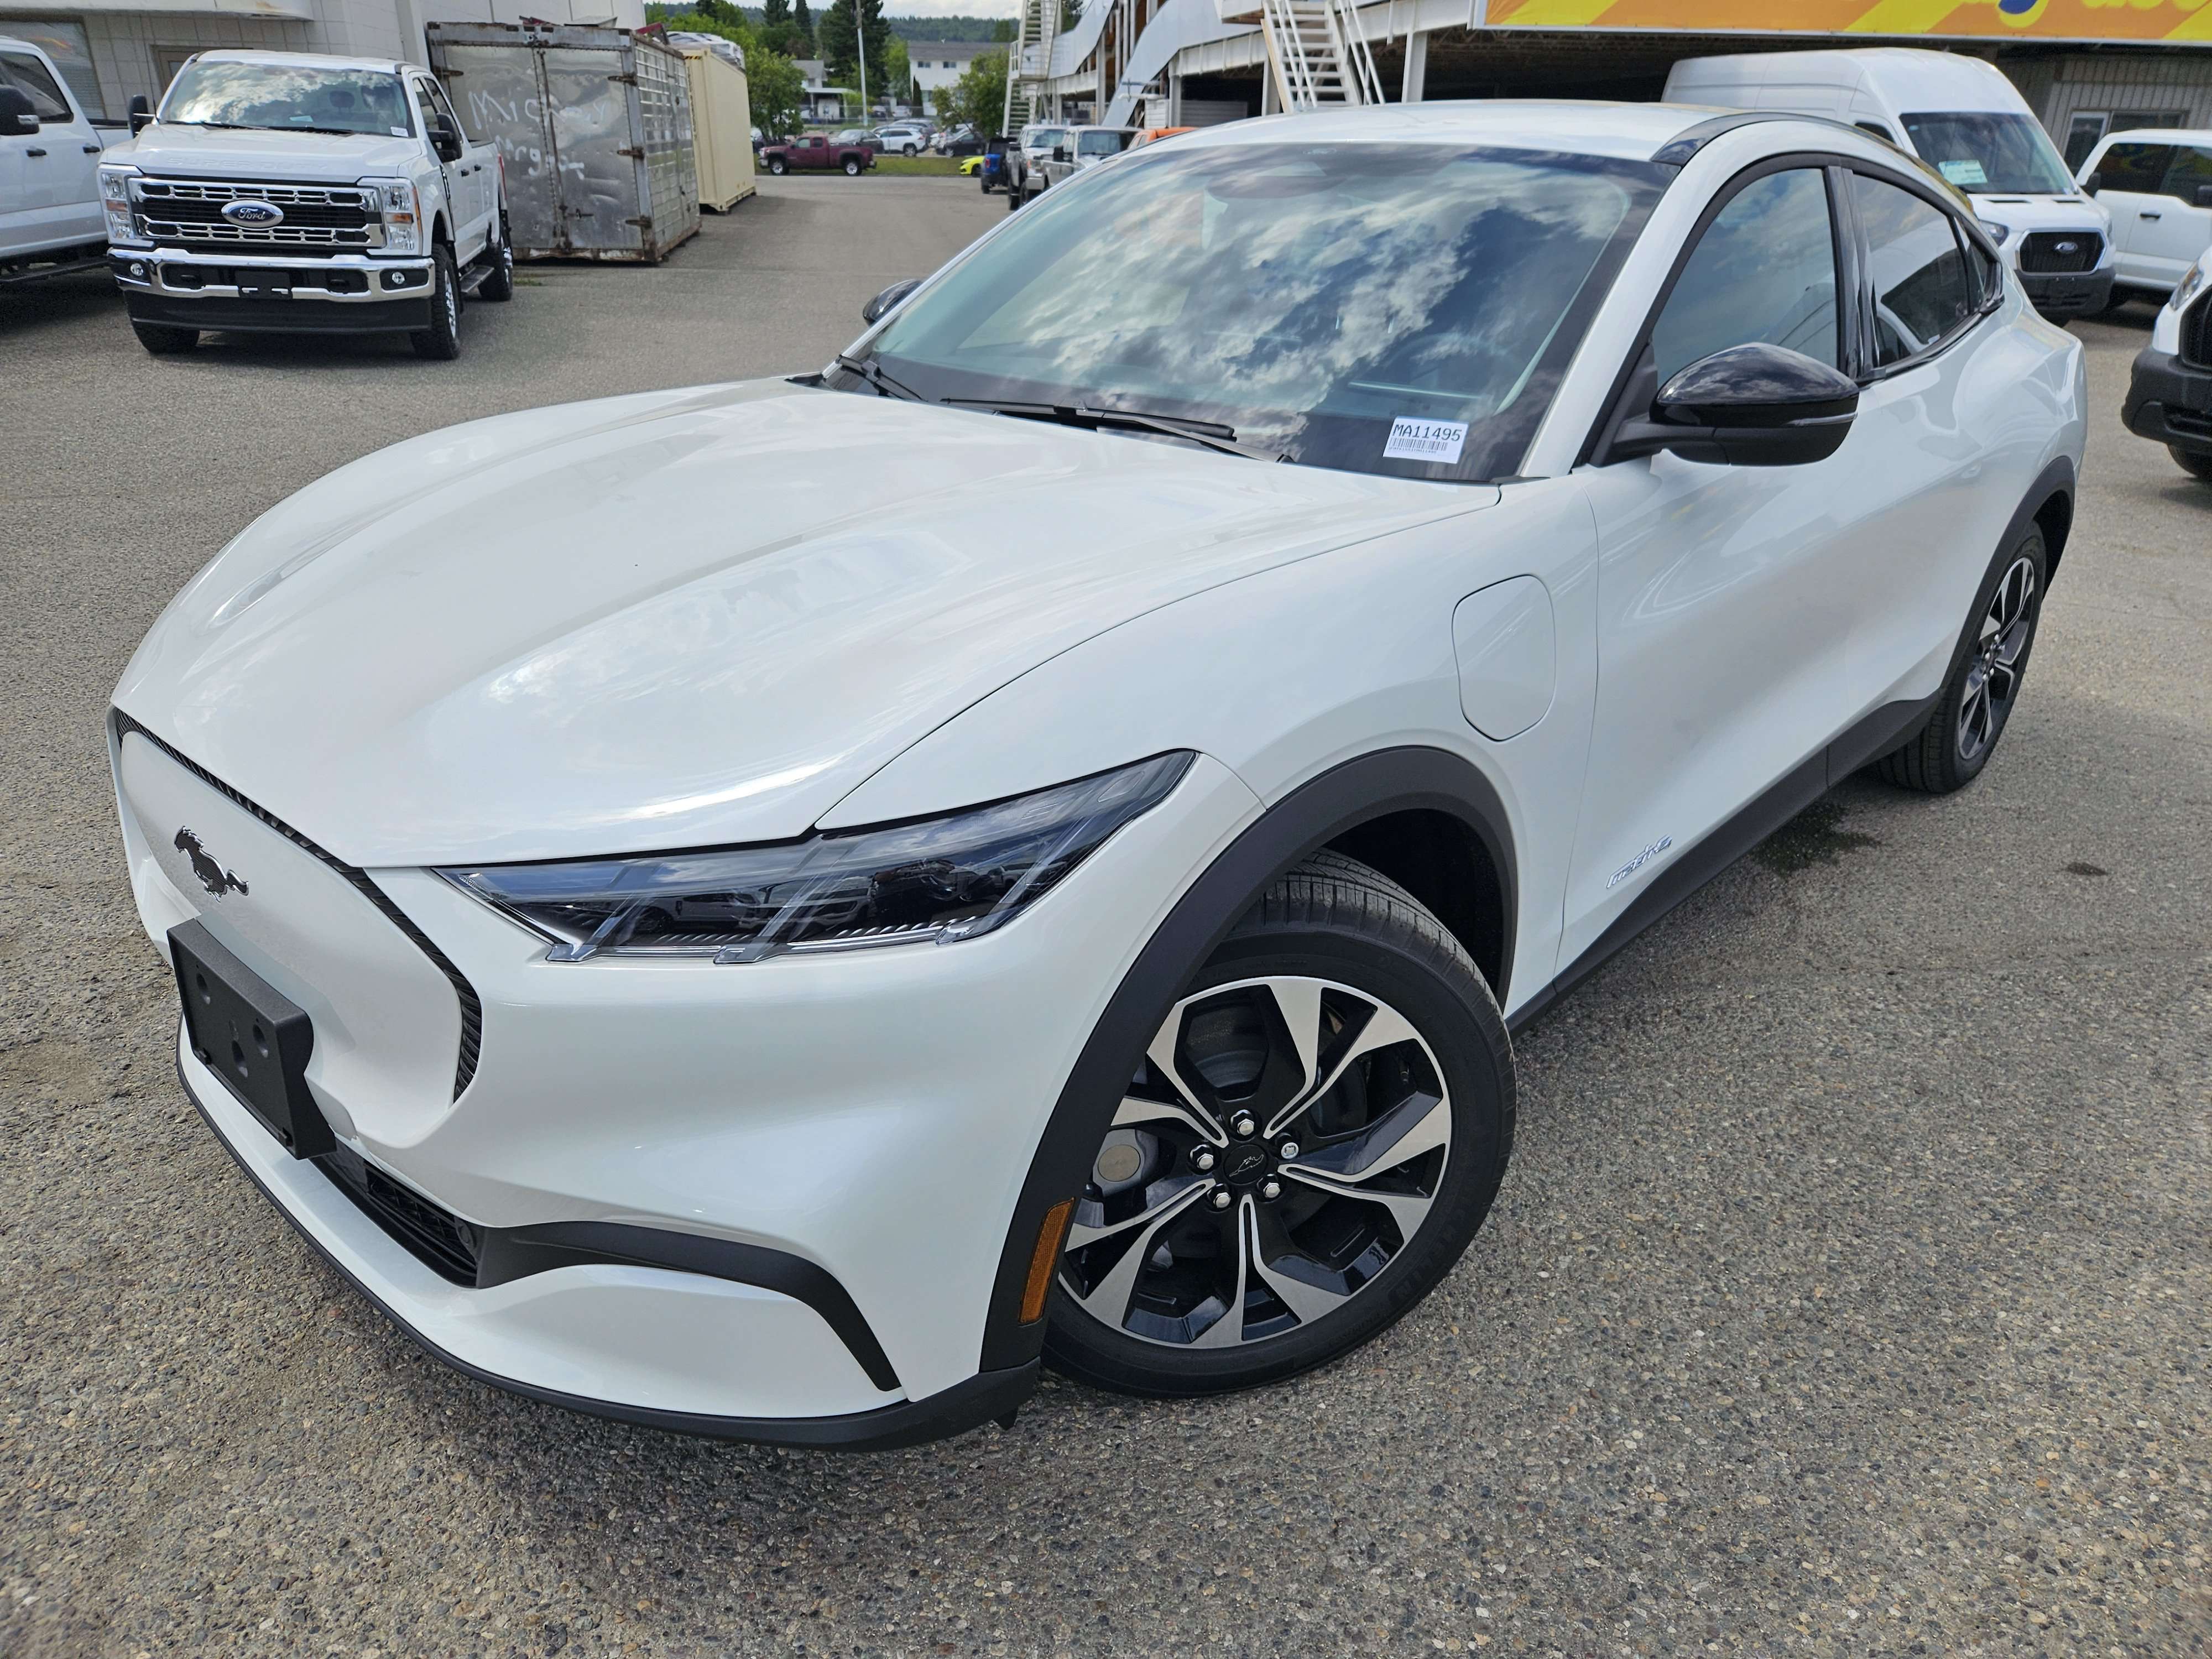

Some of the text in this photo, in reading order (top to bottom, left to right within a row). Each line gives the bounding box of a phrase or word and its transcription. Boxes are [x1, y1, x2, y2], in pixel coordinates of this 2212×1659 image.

[166, 156, 330, 172] SUPER DUTY
[238, 207, 266, 220] Ford
[1392, 424, 1463, 442] MA11495
